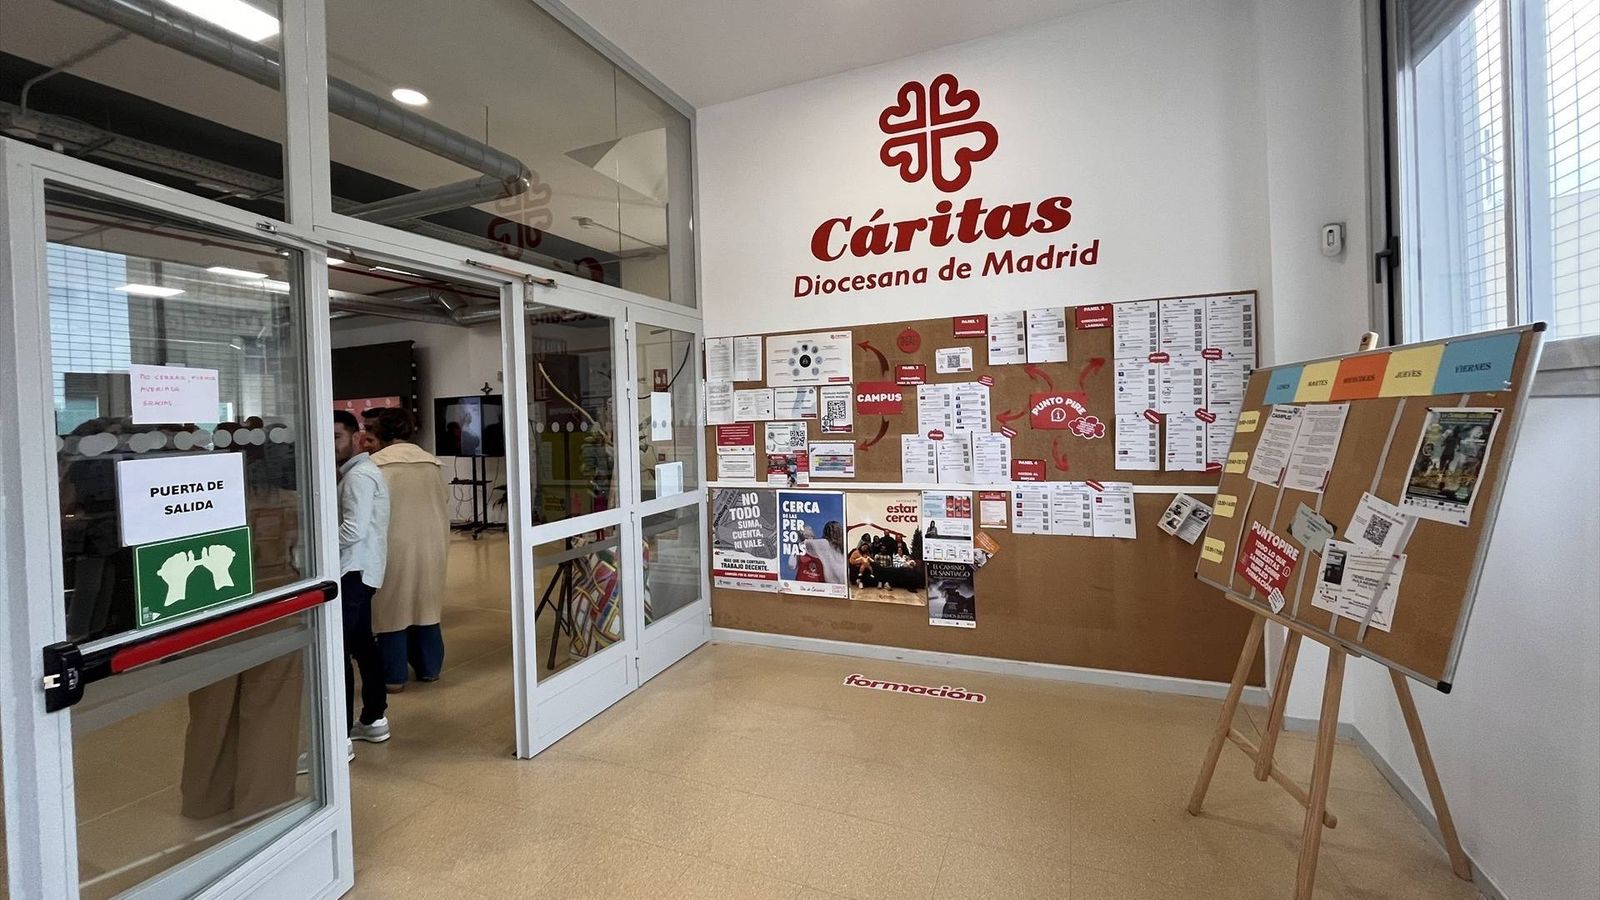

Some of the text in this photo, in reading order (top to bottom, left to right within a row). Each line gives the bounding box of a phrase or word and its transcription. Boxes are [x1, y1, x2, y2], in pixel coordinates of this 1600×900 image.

[810, 196, 1073, 262] Cáritas
[794, 239, 1100, 298] Diocesana de Madrid
[1395, 370, 1422, 379] JUEVES
[1455, 362, 1492, 374] VIERNES
[857, 393, 903, 403] CAMPUS
[1031, 396, 1087, 416] PUNTO PIRE
[150, 480, 224, 498] PUERTA DE
[741, 492, 759, 506] NO
[164, 500, 214, 515] SALIDA
[729, 505, 761, 521] TODO
[782, 500, 820, 514] CERCA
[886, 503, 918, 513] estar
[737, 519, 762, 529] SUMA,
[783, 519, 805, 531] PER
[886, 514, 918, 523] cerca
[732, 529, 764, 539] CUENTA,
[783, 531, 798, 543] SO
[1252, 520, 1300, 561] PUNTOPIRE
[733, 539, 765, 549] NI VALE.
[783, 543, 807, 556] NAS
[1255, 540, 1268, 553] TODO
[1268, 550, 1276, 559] LO
[721, 562, 744, 570] TRABAJO
[1254, 548, 1280, 571] NECESITAS
[1250, 562, 1274, 585] EMPLEO Y
[1264, 564, 1281, 580] SOBRE
[845, 675, 985, 703] formación
